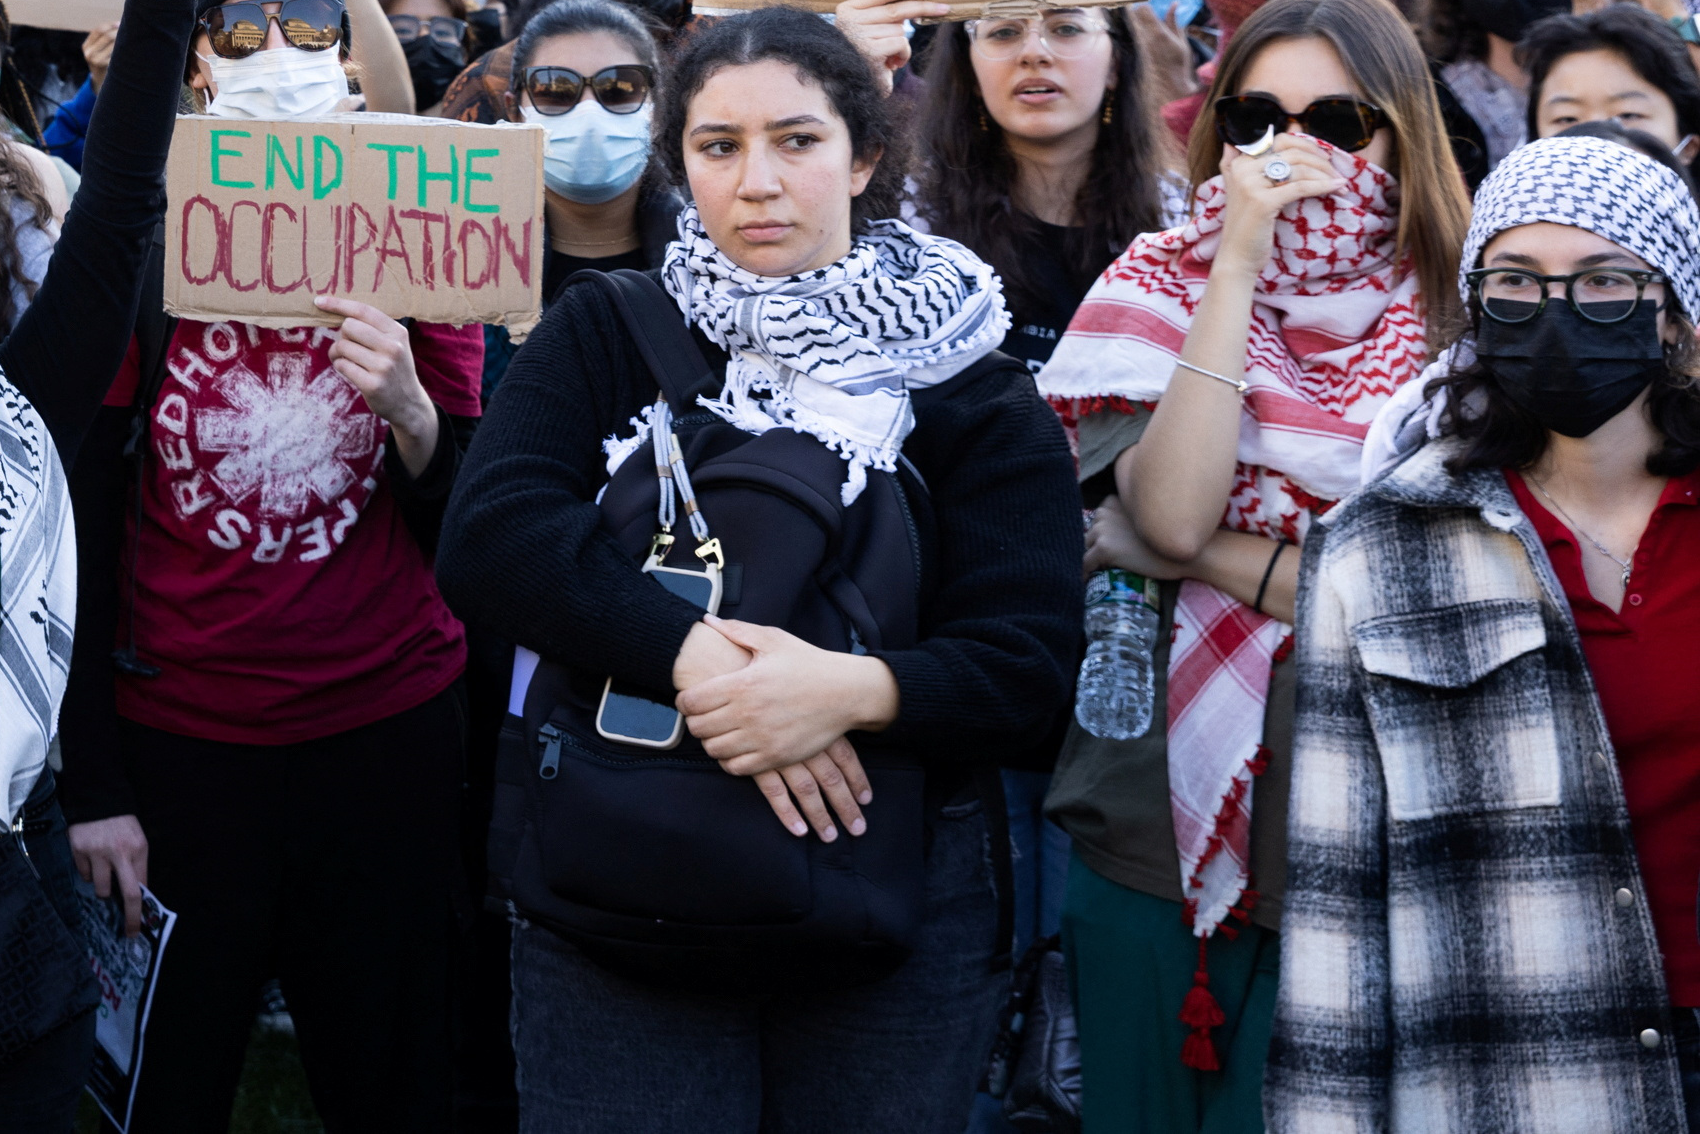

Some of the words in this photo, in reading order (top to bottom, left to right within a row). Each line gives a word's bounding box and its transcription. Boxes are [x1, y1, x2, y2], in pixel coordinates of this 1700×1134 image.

[209, 129, 345, 201] END
[366, 142, 500, 214] THE
[181, 193, 533, 296] OCCUPATION
